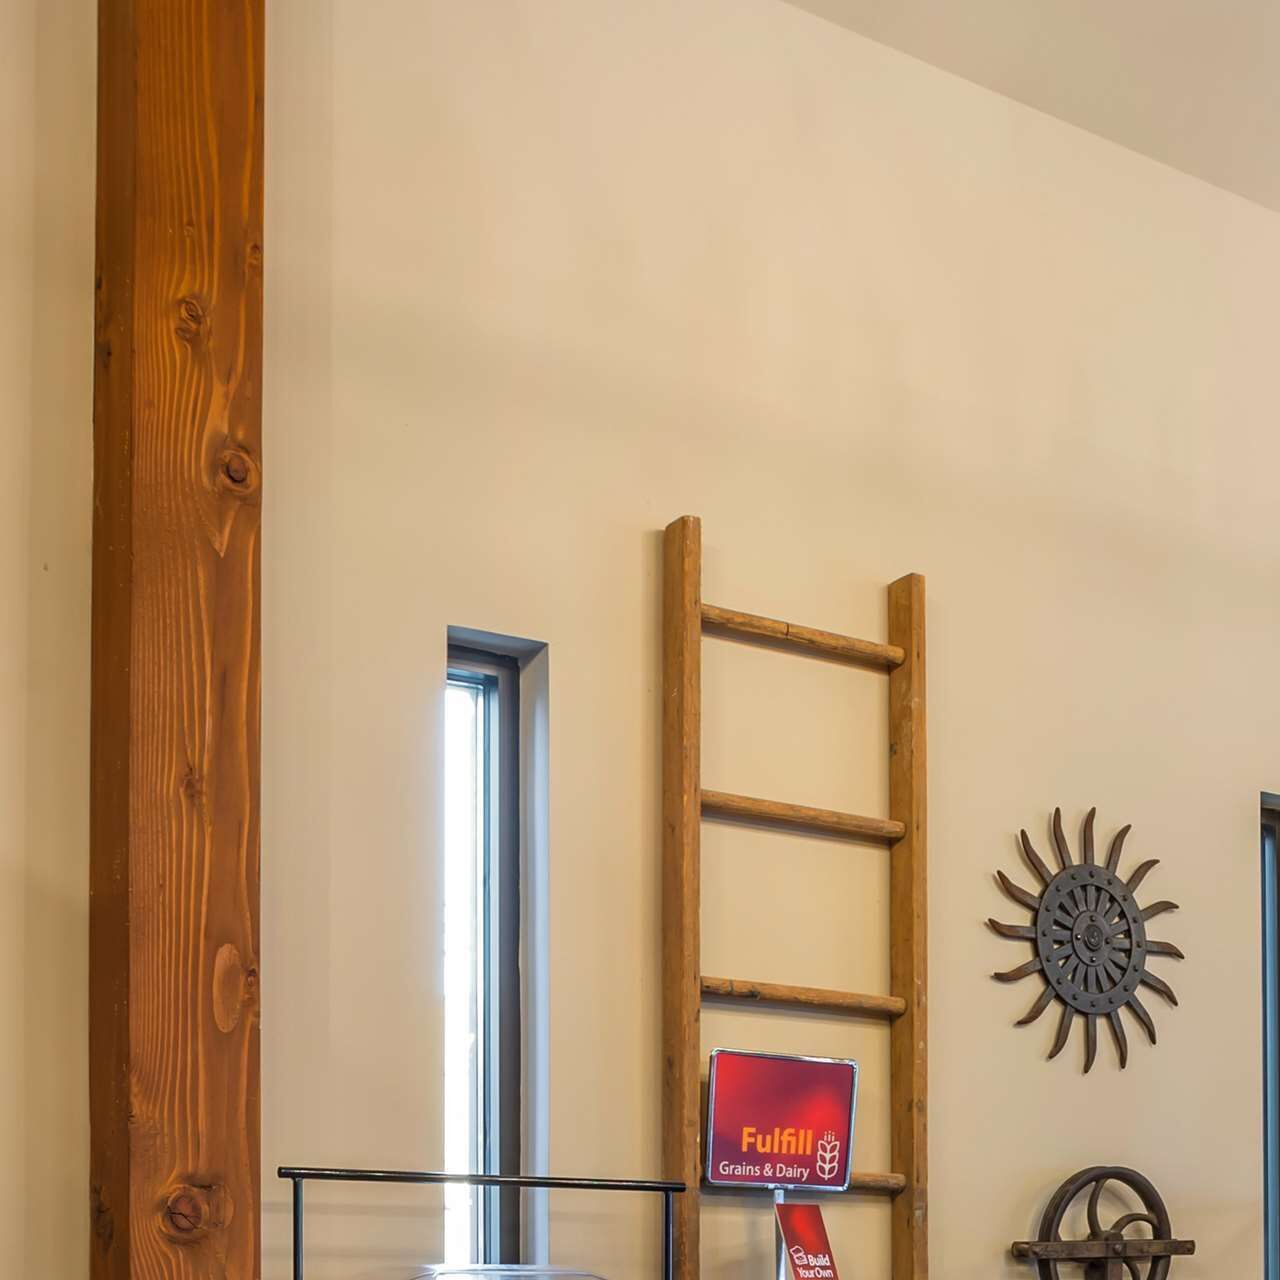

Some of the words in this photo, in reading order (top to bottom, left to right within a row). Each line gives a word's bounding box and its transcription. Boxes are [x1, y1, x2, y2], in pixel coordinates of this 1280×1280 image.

[742, 1127, 813, 1156] Fulfill
[719, 1161, 761, 1177] Grains
[763, 1163, 773, 1178] &
[776, 1163, 810, 1181] Dairy
[808, 1254, 830, 1266] Build
[797, 1267, 815, 1278] Your
[815, 1267, 833, 1278] Own
